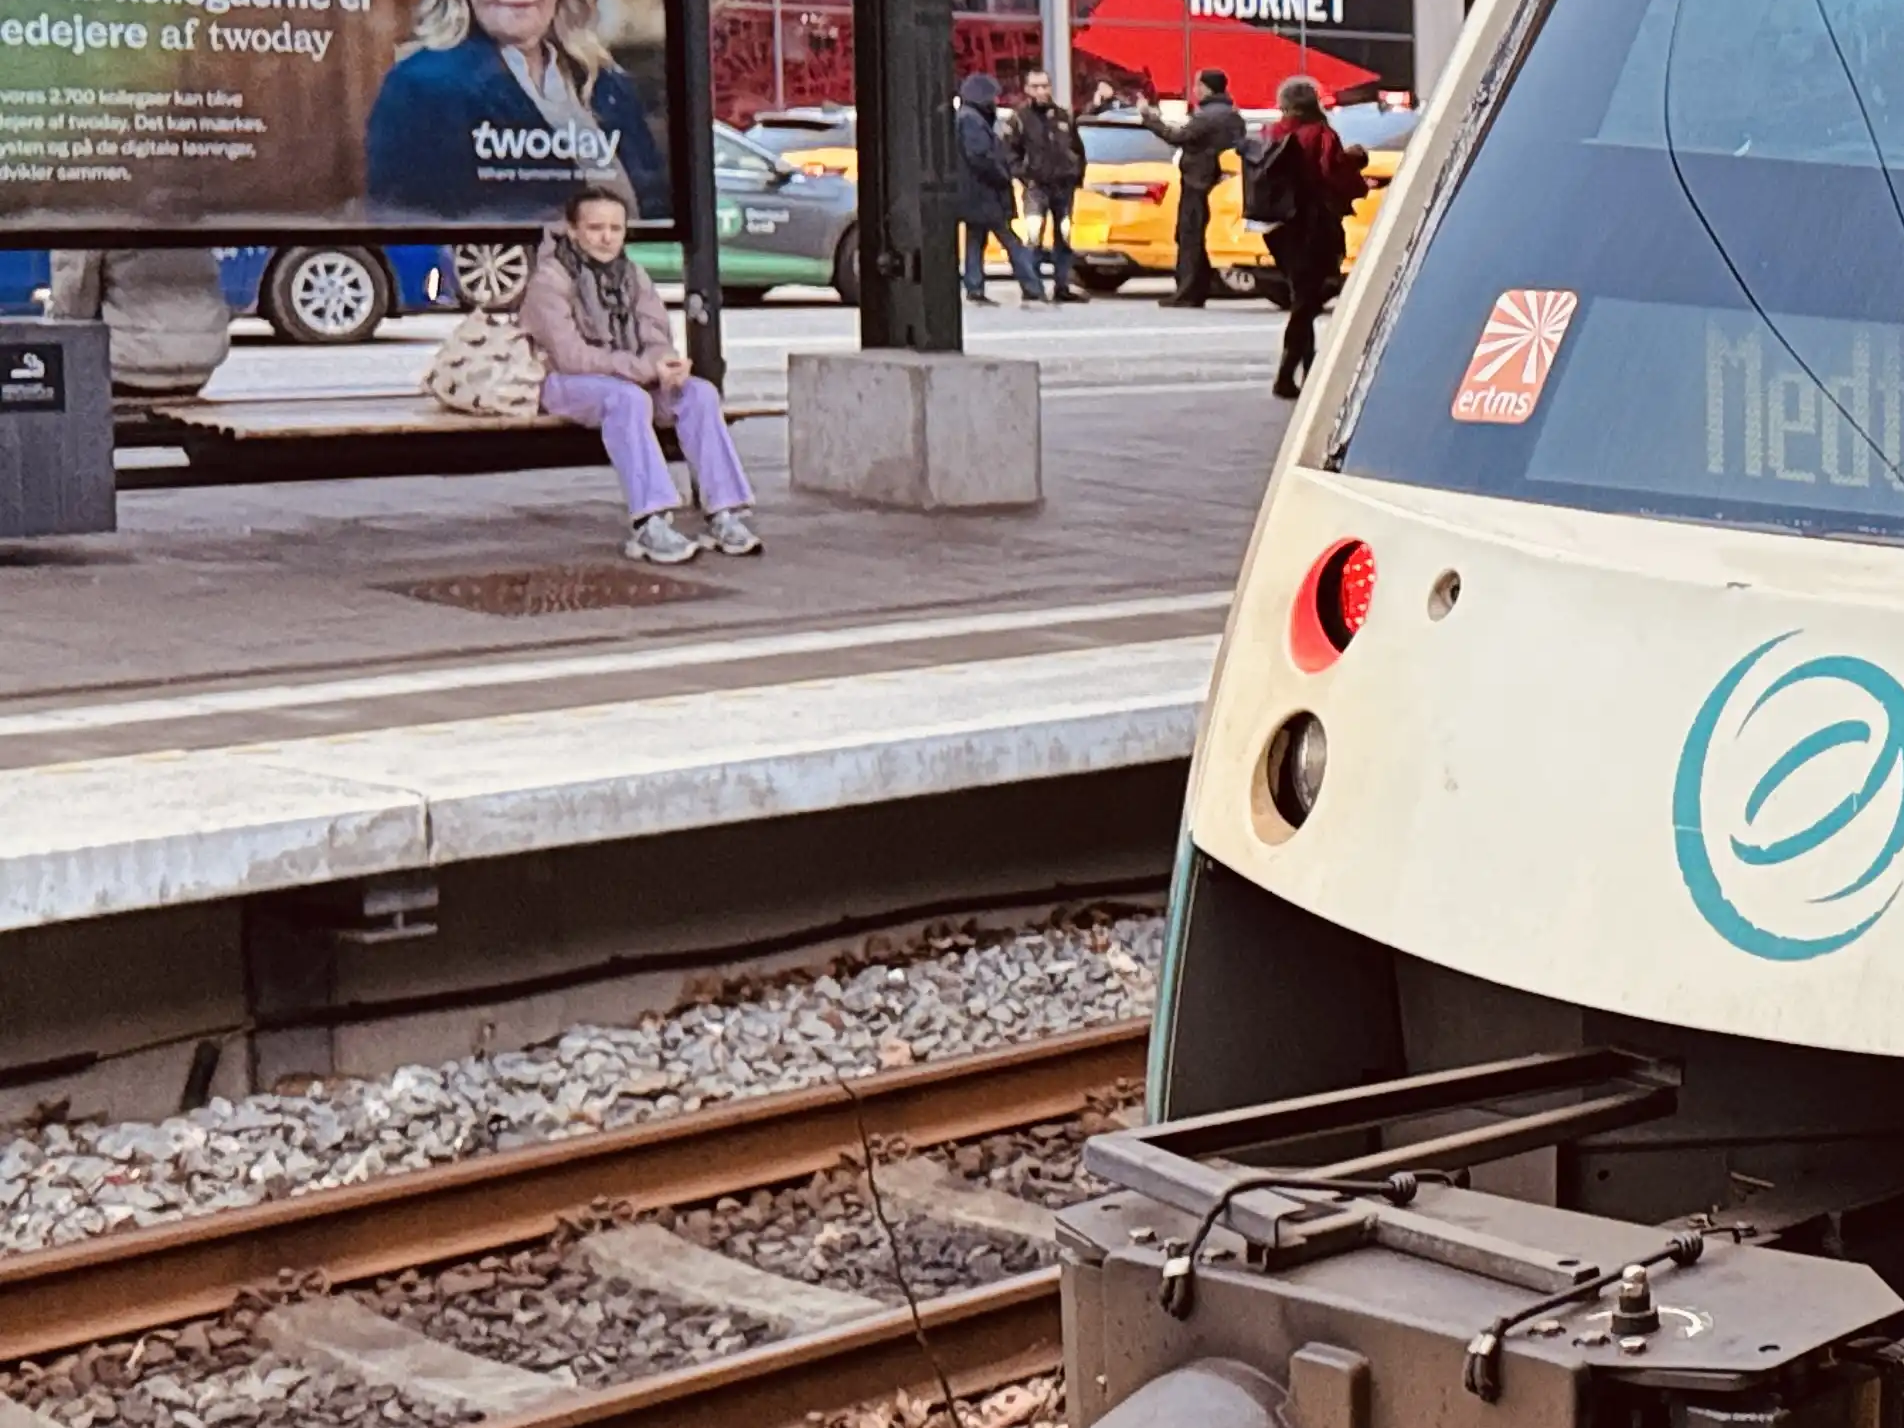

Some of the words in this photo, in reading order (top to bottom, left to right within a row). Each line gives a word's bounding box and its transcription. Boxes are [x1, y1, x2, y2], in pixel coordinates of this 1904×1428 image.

[0, 13, 148, 55] edejere
[160, 17, 200, 52] af
[208, 20, 334, 62] twoday
[472, 118, 621, 167] twoday
[1459, 384, 1533, 417] ertms
